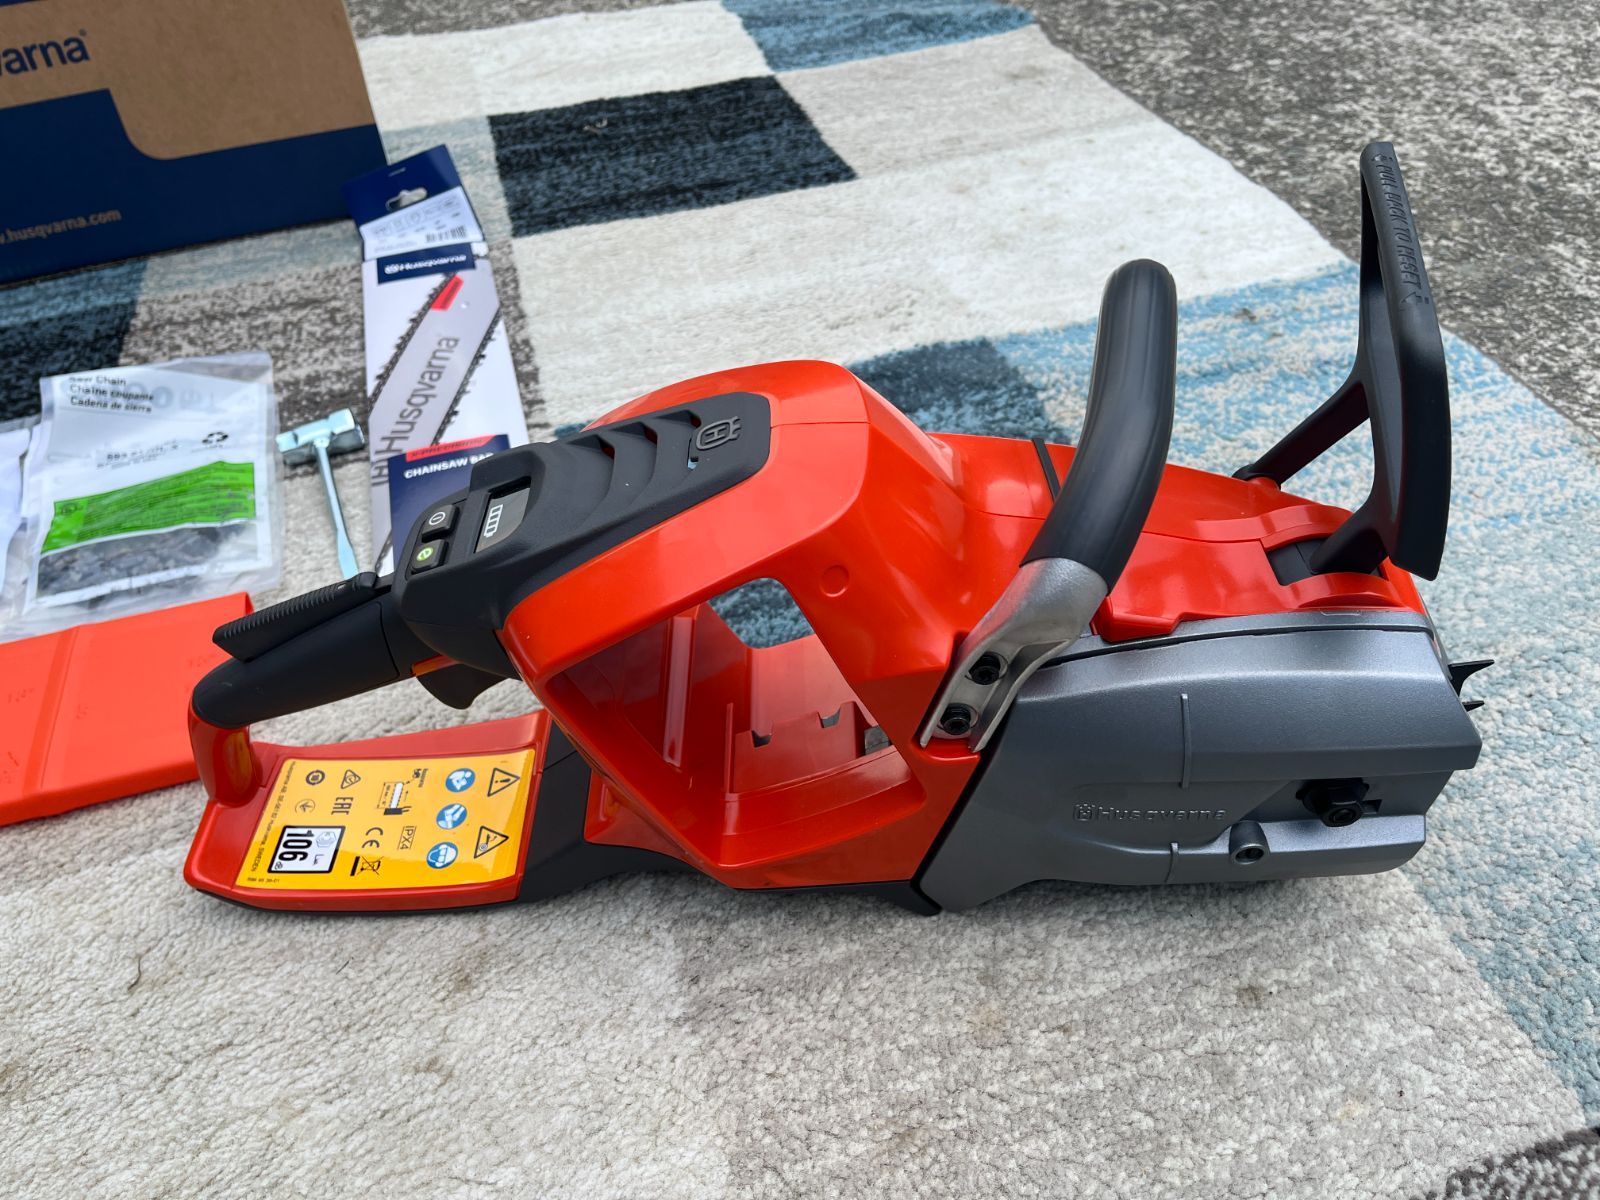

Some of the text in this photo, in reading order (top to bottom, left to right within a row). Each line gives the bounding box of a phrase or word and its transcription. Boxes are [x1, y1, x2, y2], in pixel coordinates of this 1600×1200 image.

[0, 36, 91, 77] arna
[1375, 164, 1422, 290] PULL BACK TO RESET
[96, 375, 127, 385] Chain
[70, 395, 152, 413] Cadena de sierra
[110, 389, 154, 401] coupante
[374, 336, 460, 454] Husqvarna
[404, 456, 469, 479] CHAINSAW
[1098, 805, 1226, 823] Husqvarna
[278, 829, 315, 862] 106
[361, 826, 384, 849] CE
[399, 825, 415, 850] IPX4
